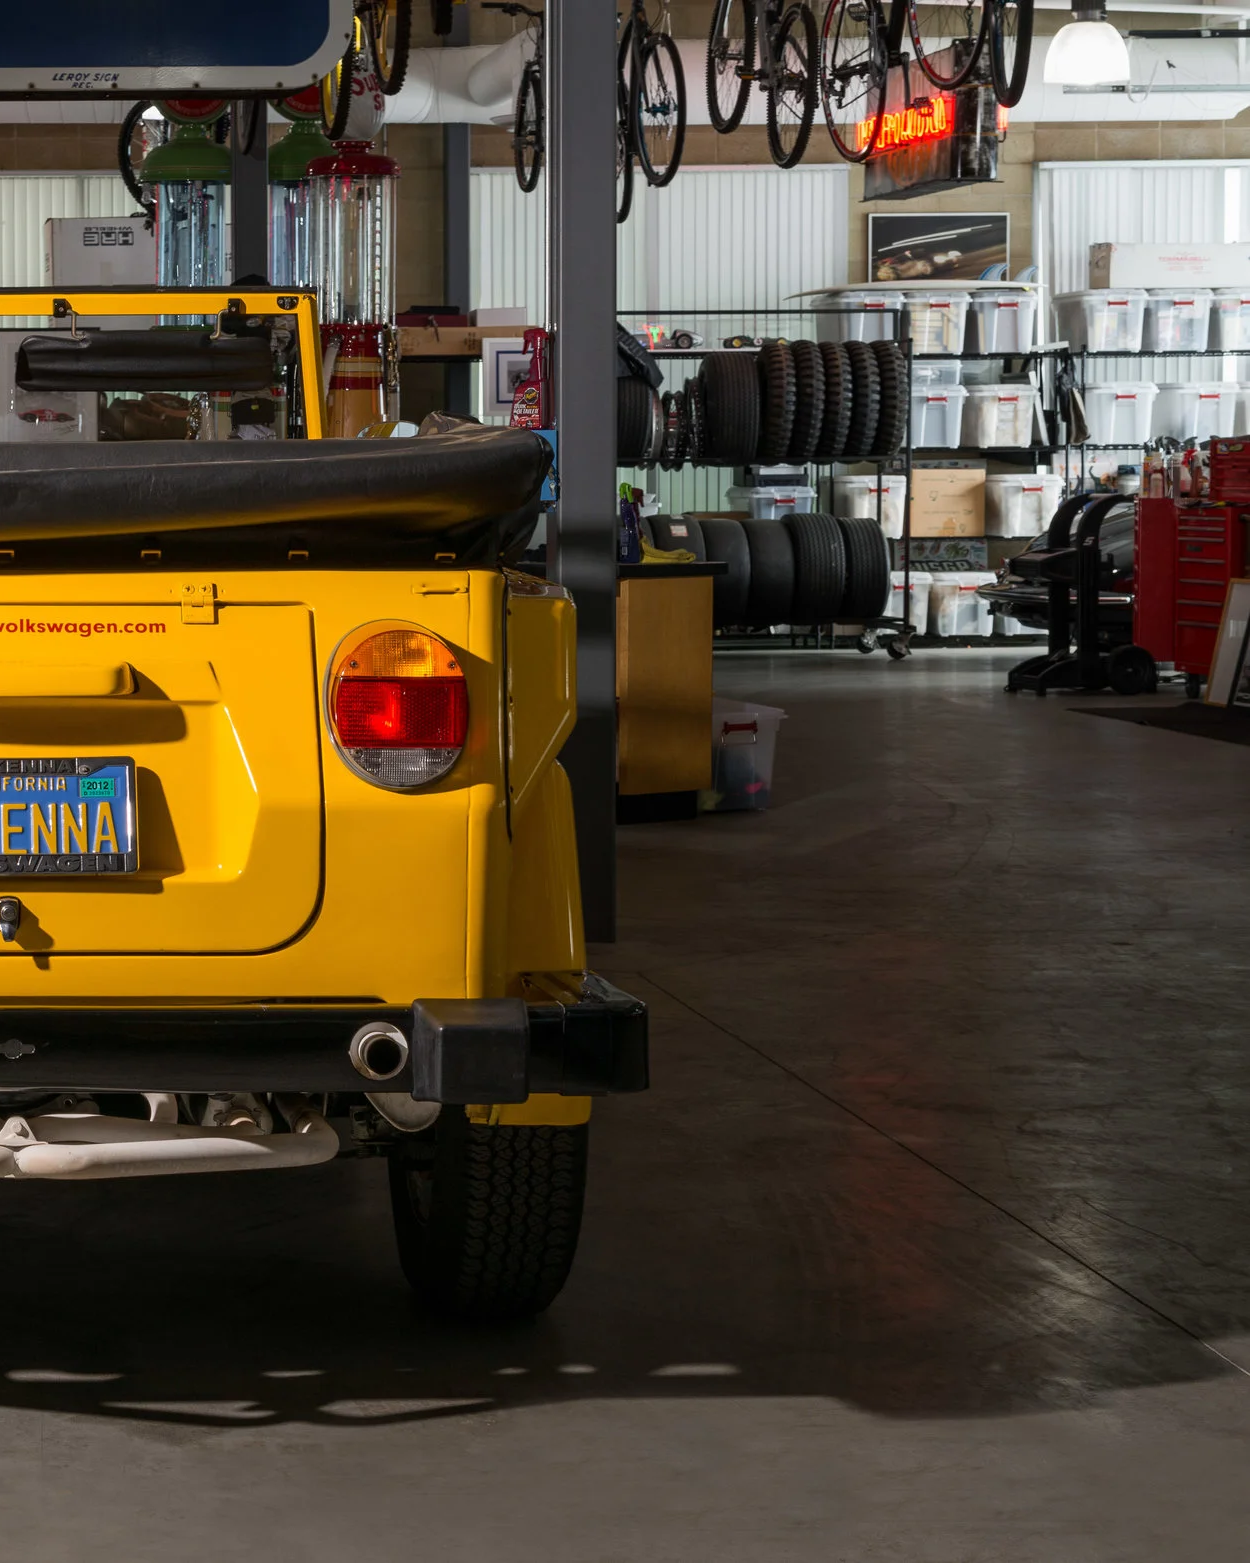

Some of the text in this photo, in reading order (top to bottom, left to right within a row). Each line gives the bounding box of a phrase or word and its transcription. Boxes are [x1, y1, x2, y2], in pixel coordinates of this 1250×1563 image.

[52, 73, 120, 81] LEROY SIGN
[83, 231, 134, 246] HRE
[86, 781, 109, 790] 2012
